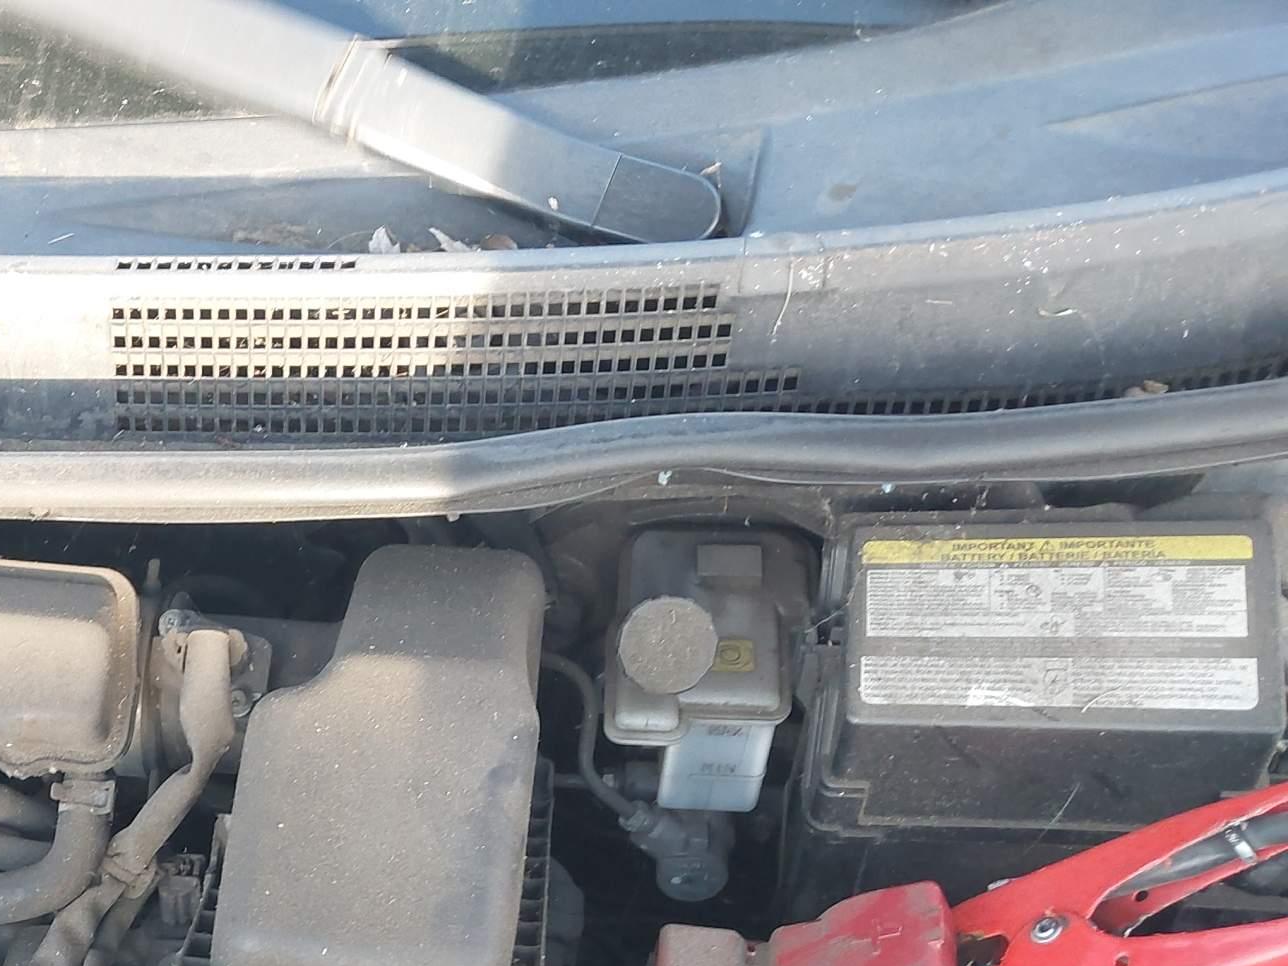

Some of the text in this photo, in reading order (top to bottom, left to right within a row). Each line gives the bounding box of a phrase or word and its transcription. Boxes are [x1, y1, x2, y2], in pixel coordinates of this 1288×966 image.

[952, 539, 1155, 552] IMPORTANT IMPORTANTE
[941, 552, 1006, 563] BATTERY
[1018, 551, 1091, 562] BATTERIE
